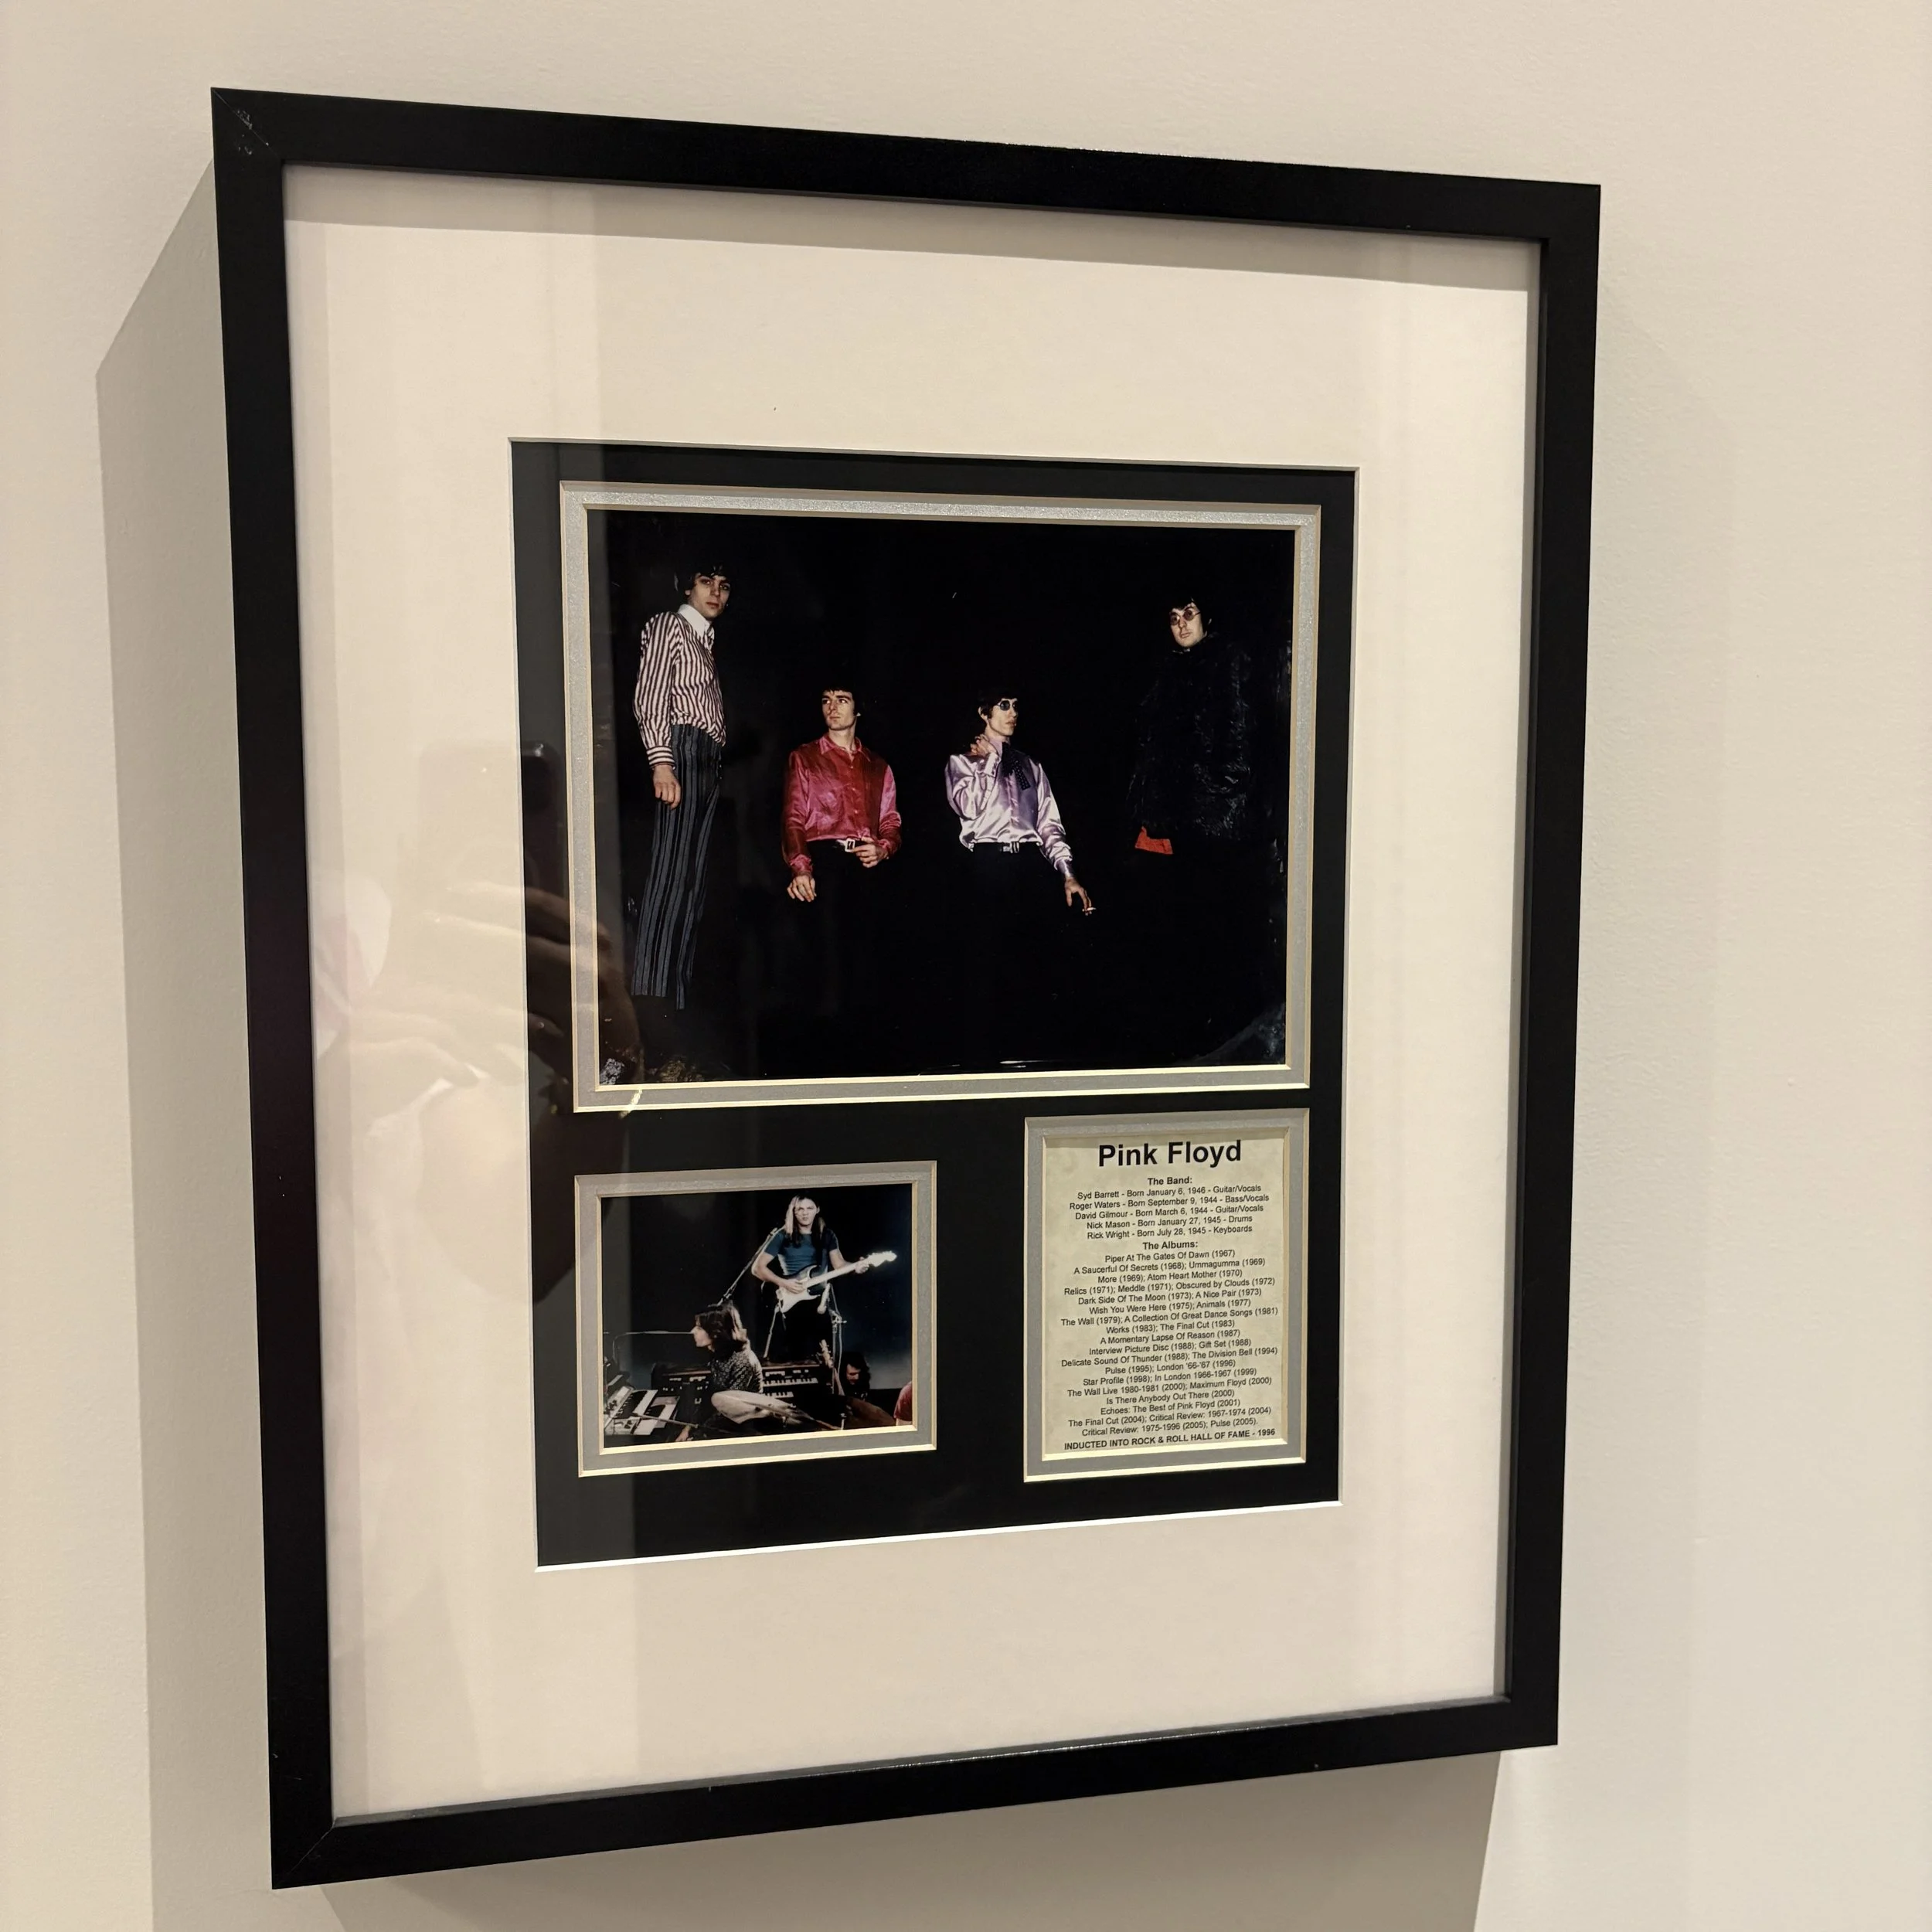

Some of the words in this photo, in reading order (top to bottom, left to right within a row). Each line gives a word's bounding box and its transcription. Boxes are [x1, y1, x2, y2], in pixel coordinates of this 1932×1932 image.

[1098, 1144, 1158, 1167] Pink
[1168, 1140, 1241, 1168] Floyd
[1077, 1192, 1092, 1200] Syd
[1146, 1188, 1176, 1197] January
[1213, 1184, 1261, 1193] Guitar/Vocals
[1069, 1202, 1092, 1211] Roger
[1147, 1198, 1188, 1208] September
[1225, 1194, 1269, 1202] Bass/Vocals
[1098, 1210, 1128, 1219] Gilmour
[1215, 1205, 1264, 1213] Guitar/Vocals
[1157, 1218, 1187, 1227] January
[1104, 1230, 1130, 1240] Wright
[1156, 1229, 1172, 1237] July
[1213, 1225, 1253, 1235] Keyboards
[1161, 1240, 1198, 1249] Albums:
[1104, 1255, 1124, 1264] Piper
[1211, 1250, 1235, 1260] (1967)
[1081, 1265, 1117, 1274] Saucerful
[1189, 1260, 1240, 1270] Ummagumma
[1241, 1258, 1265, 1267] (1969)
[1219, 1269, 1243, 1279] (1970)
[1213, 1281, 1223, 1289] by
[1251, 1277, 1275, 1287] (1972)
[1237, 1288, 1261, 1298] (1973)
[1227, 1299, 1251, 1308] (1977)
[1131, 1313, 1168, 1322] Collection
[1203, 1310, 1228, 1318] Dance
[1230, 1309, 1253, 1318] Songs
[1254, 1308, 1278, 1317] (1981)
[1211, 1320, 1235, 1329] (1983)
[1107, 1335, 1149, 1345] Momentary
[1151, 1333, 1174, 1343] Lapse
[1216, 1330, 1240, 1339] (1987)
[1089, 1346, 1123, 1355] Interview
[1227, 1339, 1251, 1349] (1988)
[1061, 1359, 1091, 1367] Delicate
[1131, 1354, 1162, 1362] Thunder
[1208, 1350, 1236, 1359] Division
[1254, 1348, 1277, 1357] (1994)
[1104, 1366, 1126, 1374] Pulse
[1156, 1362, 1184, 1371] London
[1212, 1360, 1236, 1369] (1996)
[1233, 1369, 1257, 1378] (1999)
[1189, 1380, 1225, 1389] Maximum
[1226, 1379, 1247, 1389] Floyd
[1248, 1378, 1272, 1387] (2000)
[1138, 1393, 1171, 1403] Anybody
[1187, 1391, 1209, 1400] There
[1211, 1389, 1234, 1400] (2000)
[1195, 1401, 1215, 1410] Floyd
[1216, 1400, 1240, 1409] (2001)
[1247, 1407, 1271, 1417] (2004)
[1064, 1440, 1107, 1450] INDUCTED
[1190, 1433, 1213, 1441] HALL
[1227, 1430, 1250, 1439] FAME
